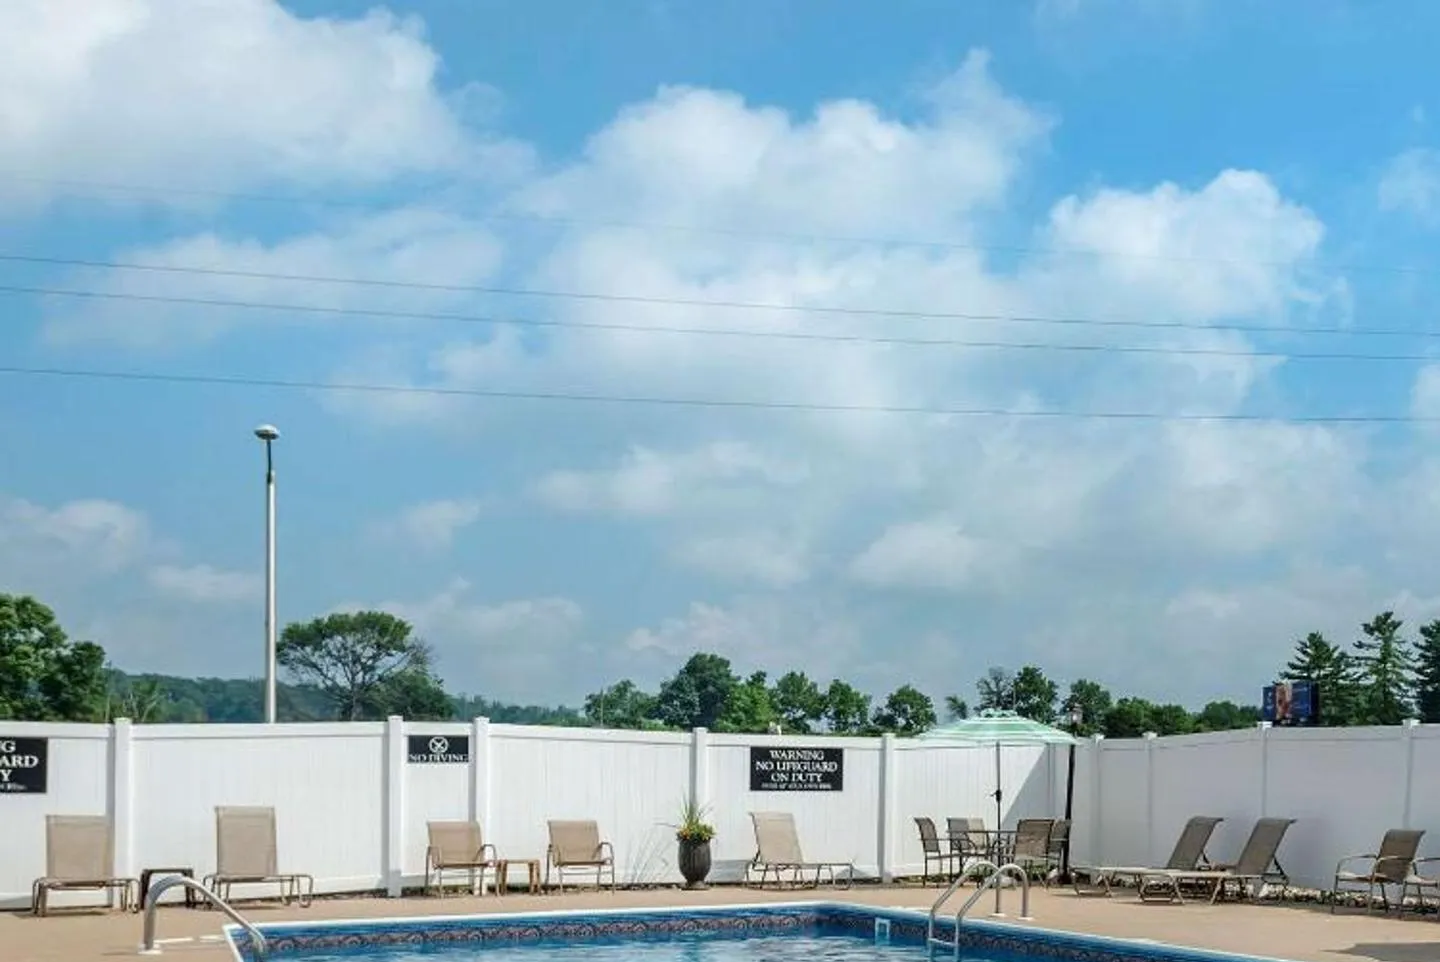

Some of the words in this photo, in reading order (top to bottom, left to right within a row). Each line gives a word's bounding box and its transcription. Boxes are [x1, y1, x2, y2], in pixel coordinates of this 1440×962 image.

[769, 749, 825, 760] WARNING
[755, 761, 774, 771] NO
[776, 761, 838, 772] LIFEGUARD
[770, 773, 789, 782] ON
[791, 773, 823, 782] DUTY
